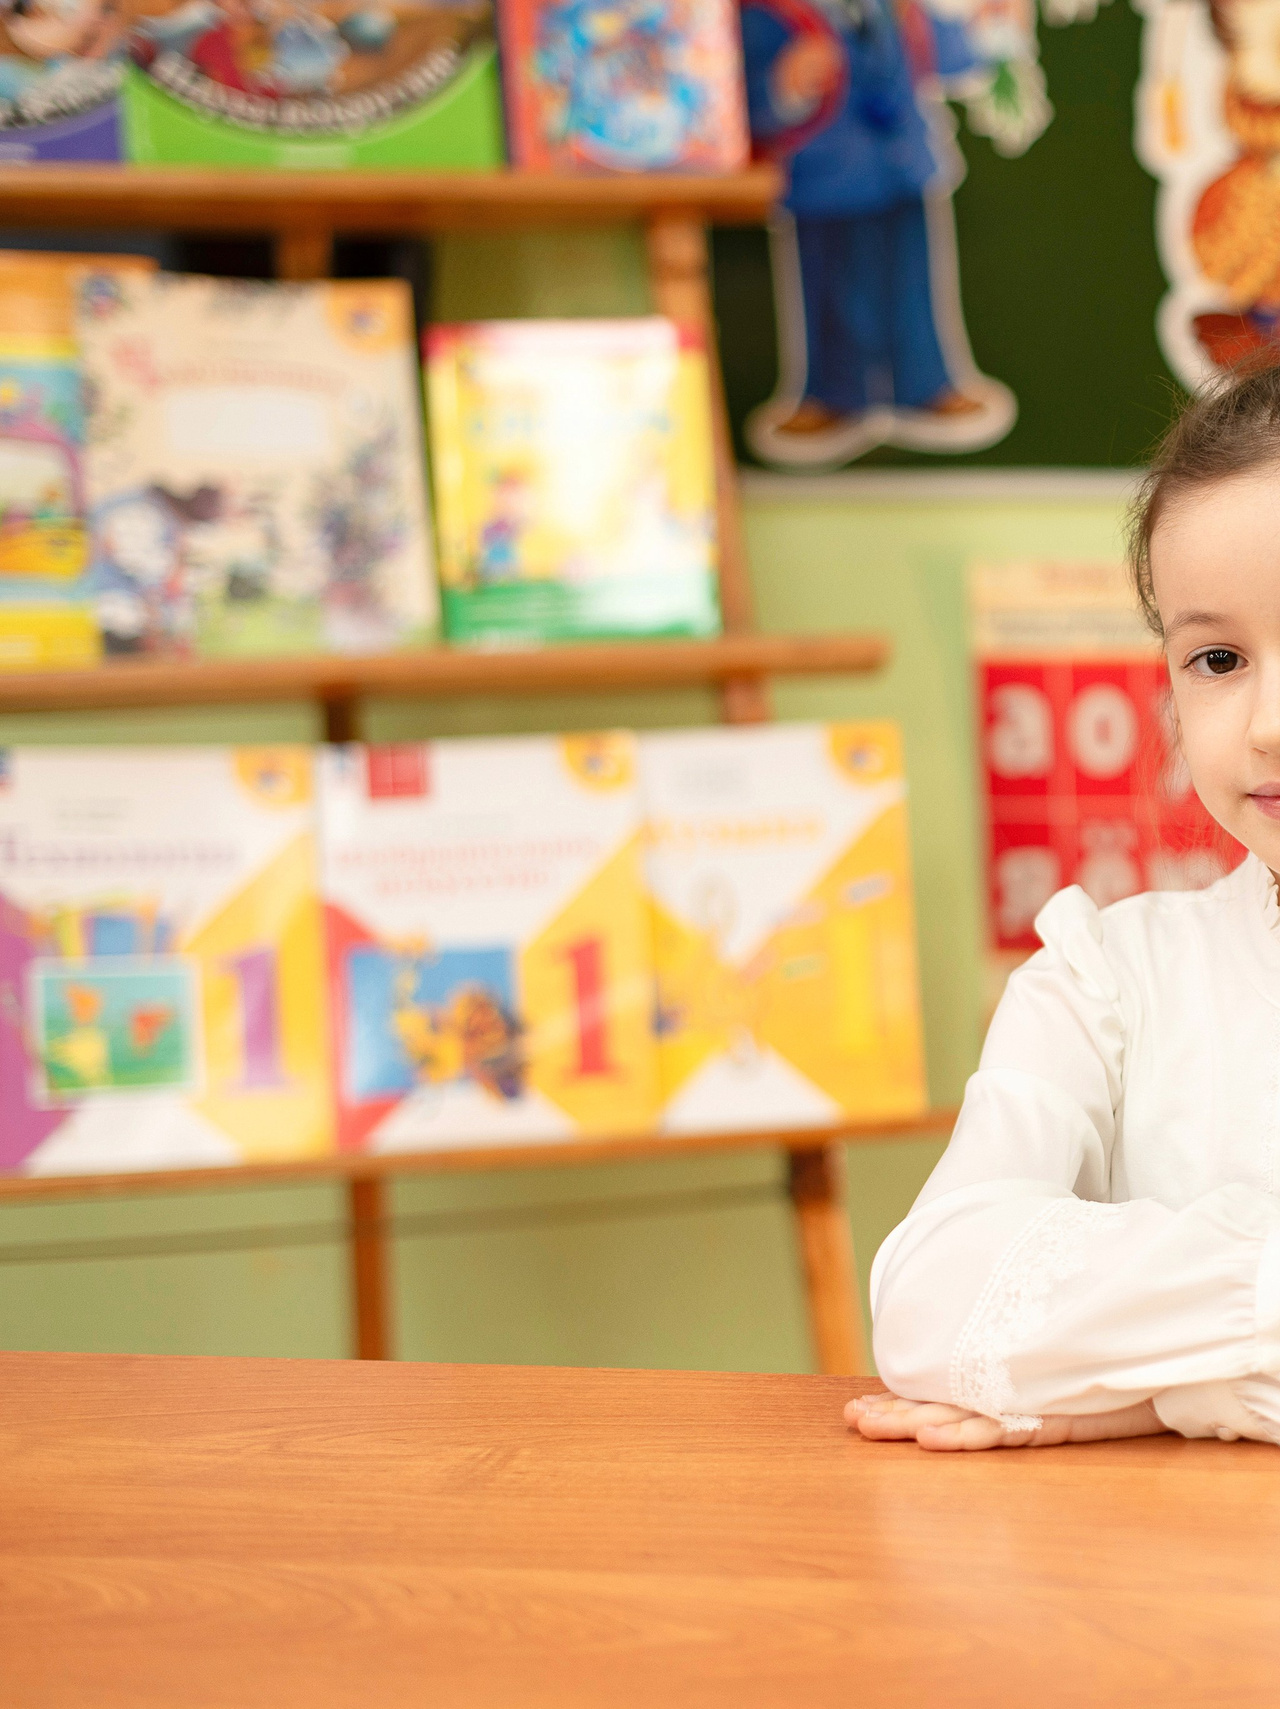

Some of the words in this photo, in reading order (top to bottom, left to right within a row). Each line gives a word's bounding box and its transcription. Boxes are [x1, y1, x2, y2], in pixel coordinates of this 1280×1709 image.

[988, 684, 1055, 779] а
[1068, 683, 1137, 779] о
[220, 945, 295, 1090] 1
[552, 930, 634, 1084] 1
